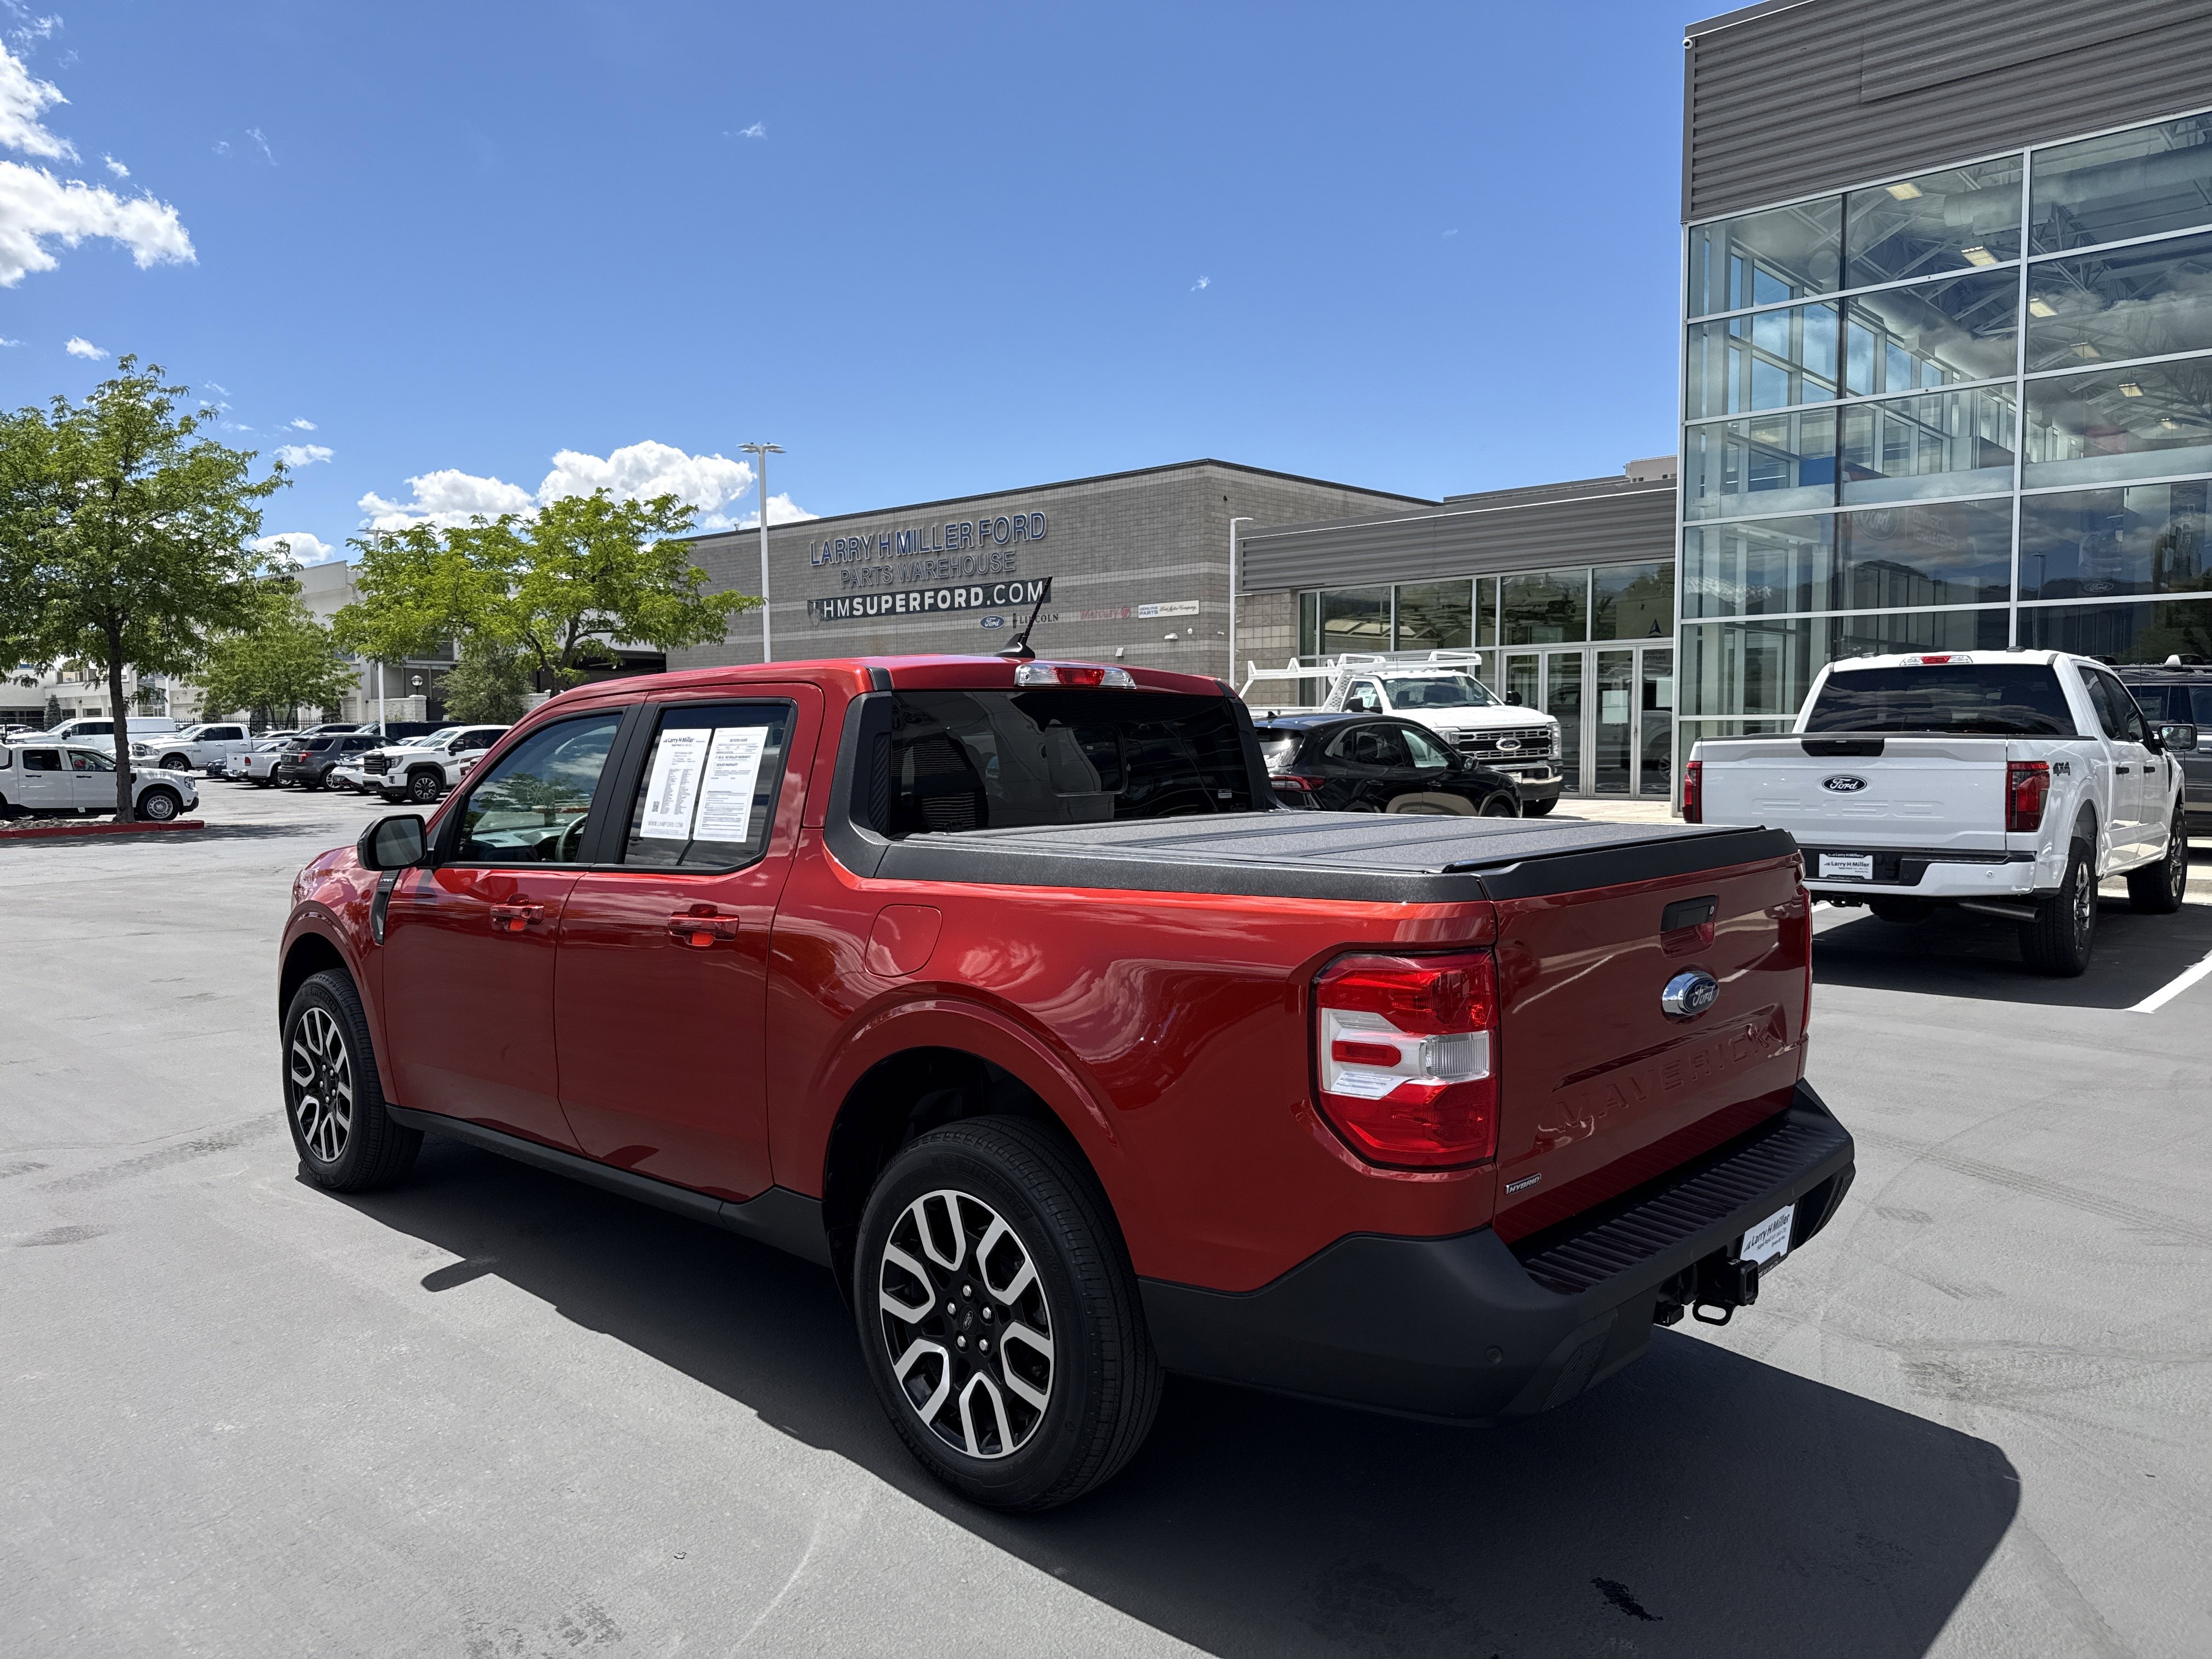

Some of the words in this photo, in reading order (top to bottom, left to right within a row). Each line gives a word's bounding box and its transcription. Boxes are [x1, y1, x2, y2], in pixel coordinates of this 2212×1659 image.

[810, 534, 873, 566] LARRY
[878, 531, 891, 558] H
[895, 521, 974, 556] MILLER
[978, 511, 1047, 547] FORD
[840, 564, 893, 588] PARTS
[897, 551, 1015, 582] WAREHOUSE
[984, 617, 1001, 628] Ford
[1830, 778, 1858, 789] Ford
[1689, 984, 1714, 1007] Ford
[1555, 1024, 1771, 1132] MAVERICK
[1509, 1176, 1539, 1193] HYBRID
[1751, 1229, 1767, 1246] Larry
[1767, 1223, 1773, 1236] H
[1772, 1214, 1790, 1232] Miller
